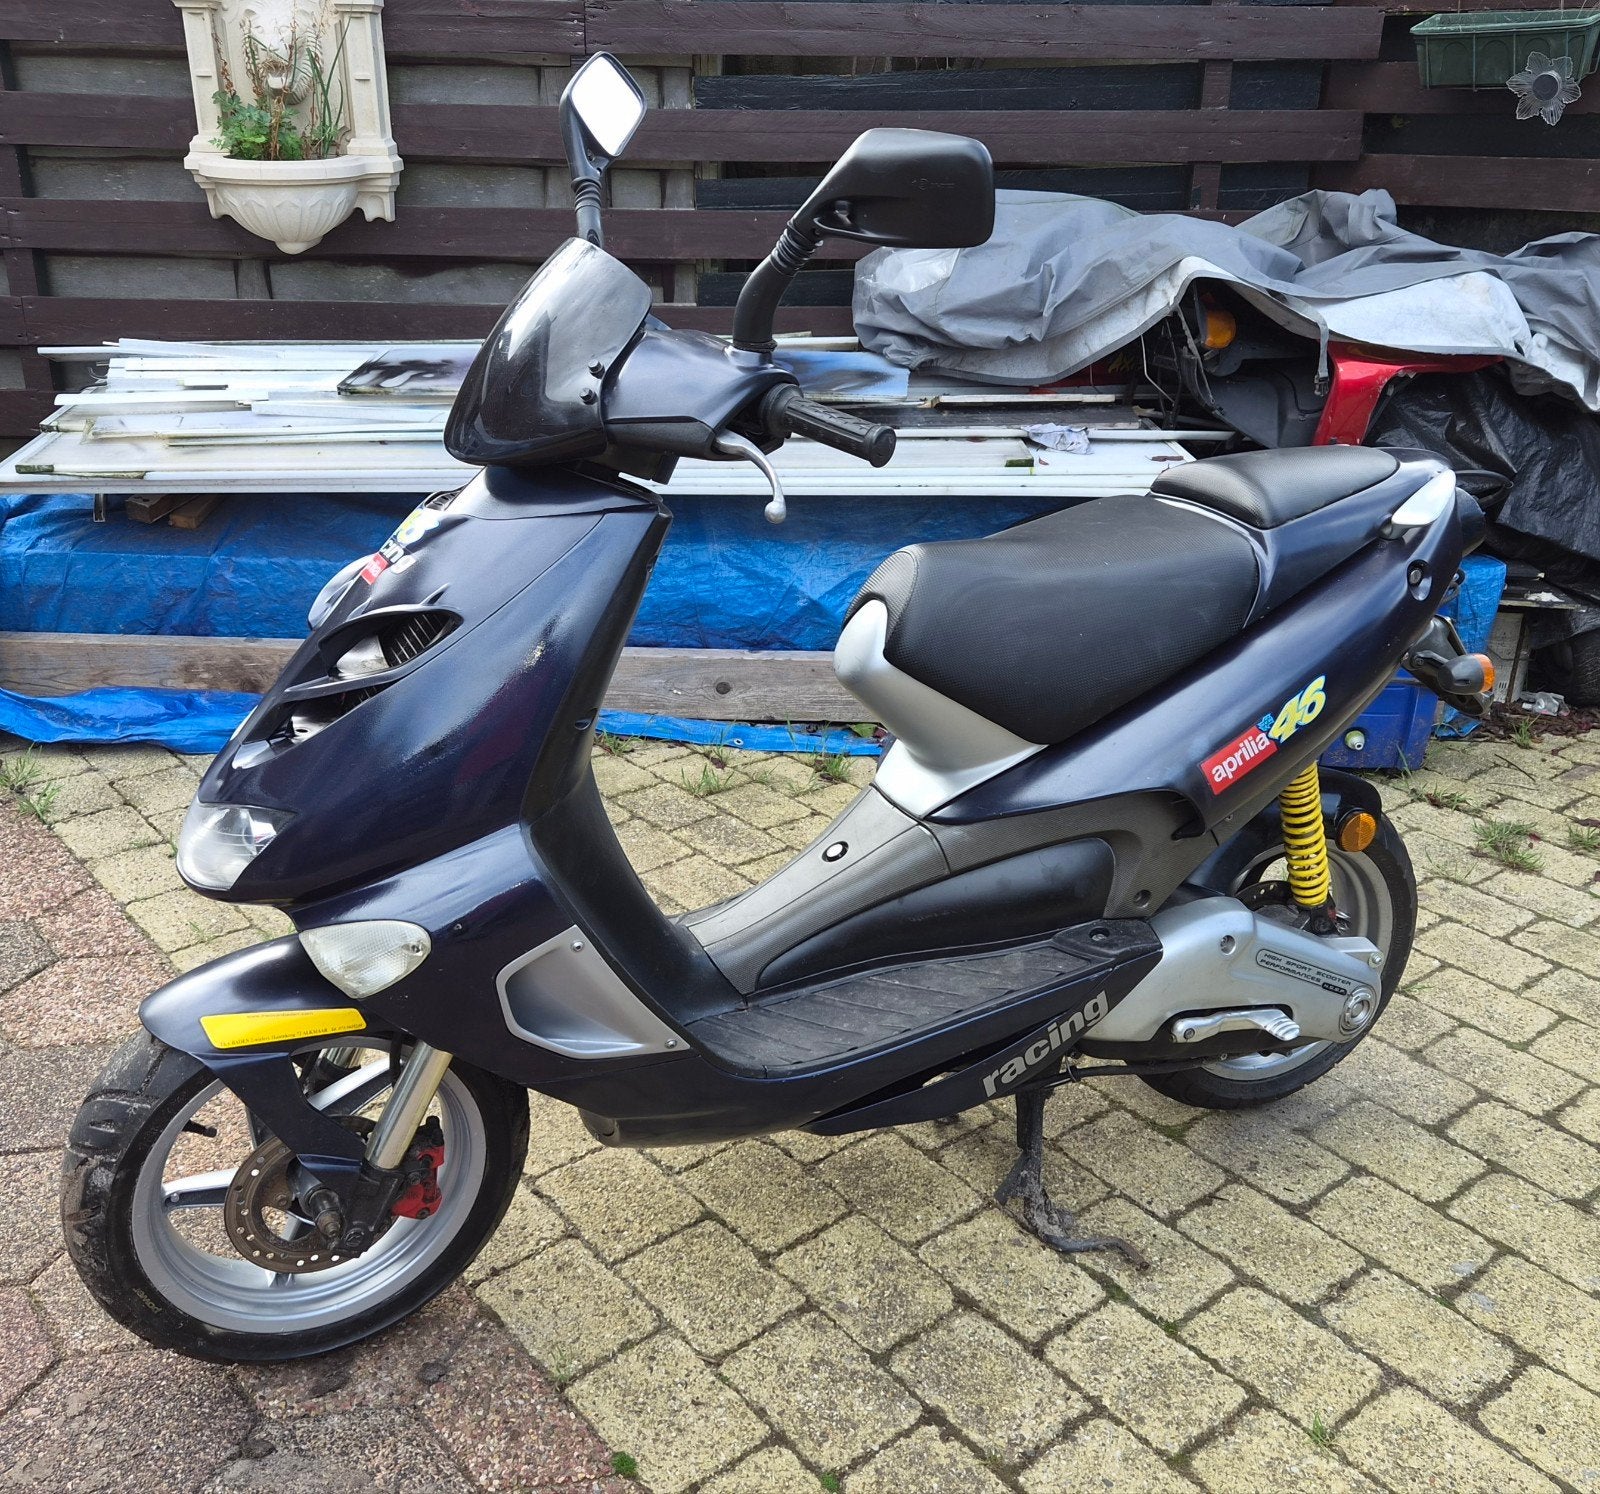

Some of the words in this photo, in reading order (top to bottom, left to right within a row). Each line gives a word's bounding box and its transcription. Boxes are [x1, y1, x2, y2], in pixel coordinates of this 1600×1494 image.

[1268, 675, 1326, 744] 46
[1211, 732, 1271, 782] aprilia
[1259, 958, 1322, 983] PERFORMANCES
[1263, 953, 1283, 963] HIGH
[1286, 960, 1312, 973] SPORT
[1316, 971, 1352, 986] SCOOTER
[982, 989, 1109, 1098] racing
